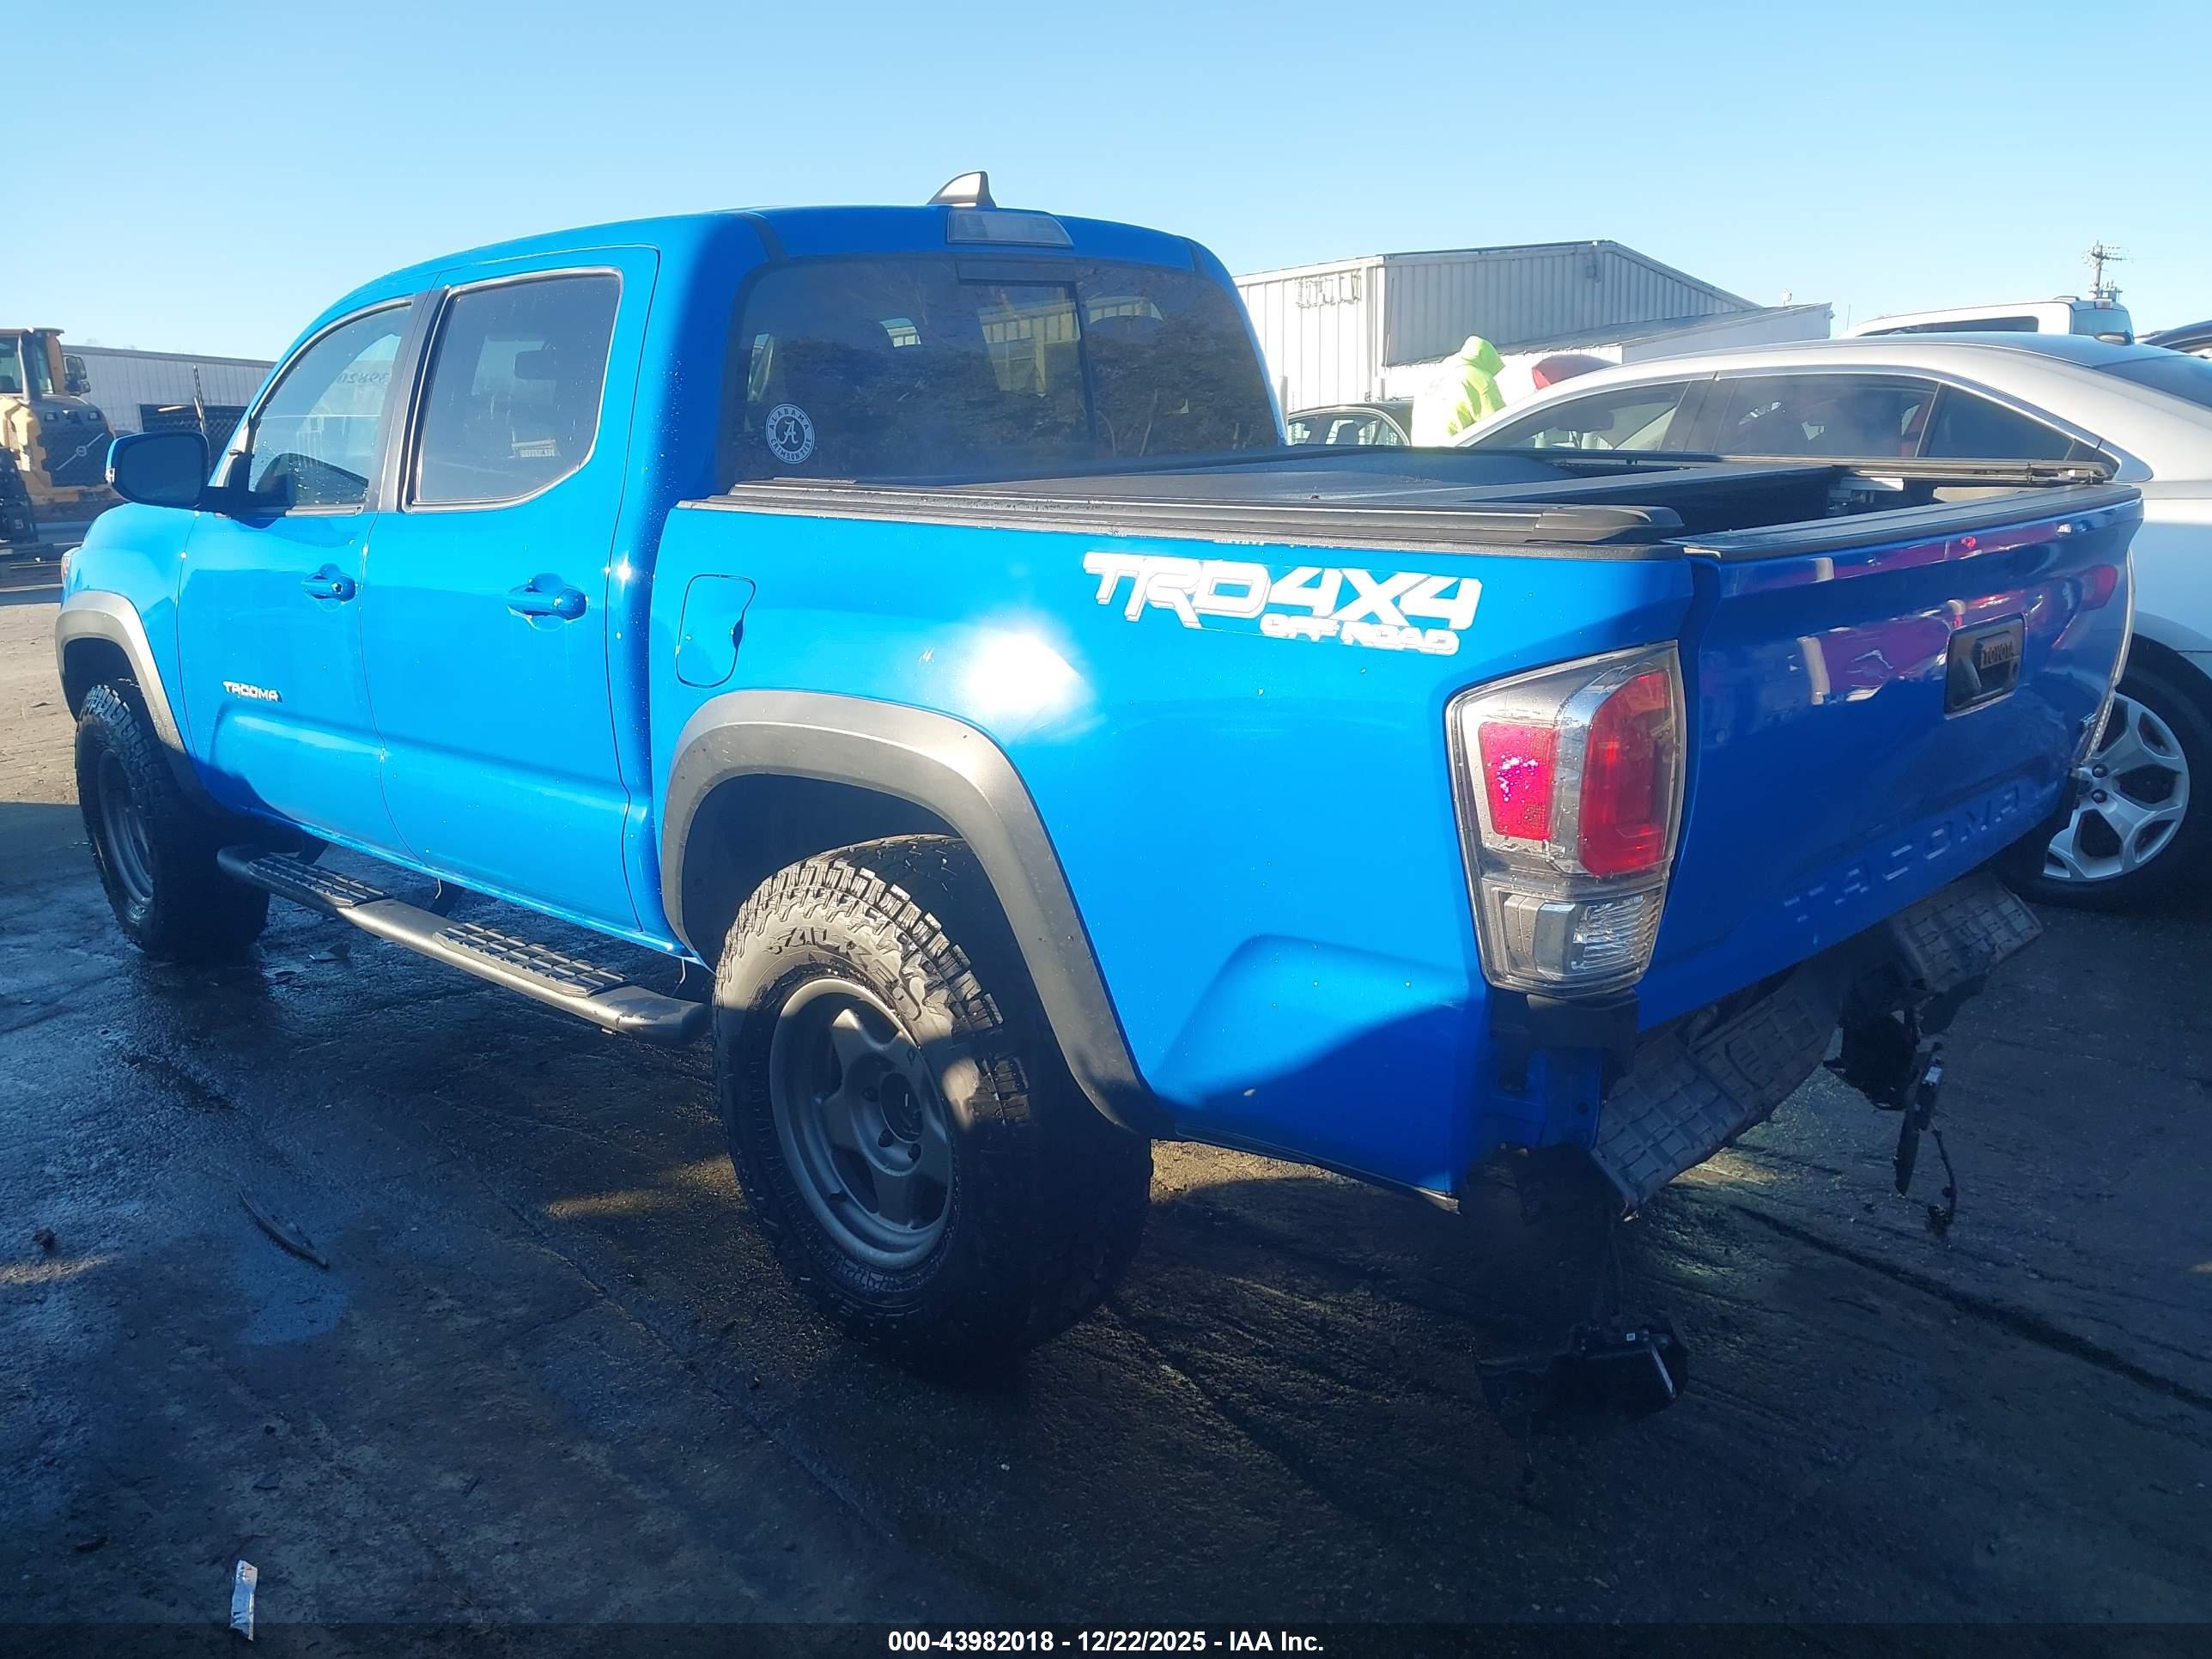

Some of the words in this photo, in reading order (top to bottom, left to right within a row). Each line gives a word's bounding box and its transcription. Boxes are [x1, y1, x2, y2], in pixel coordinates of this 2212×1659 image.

[769, 408, 810, 430] ALABAMA
[771, 438, 799, 459] CRIMSON
[1340, 620, 1460, 656] ROAD
[222, 680, 280, 702] TACOMA
